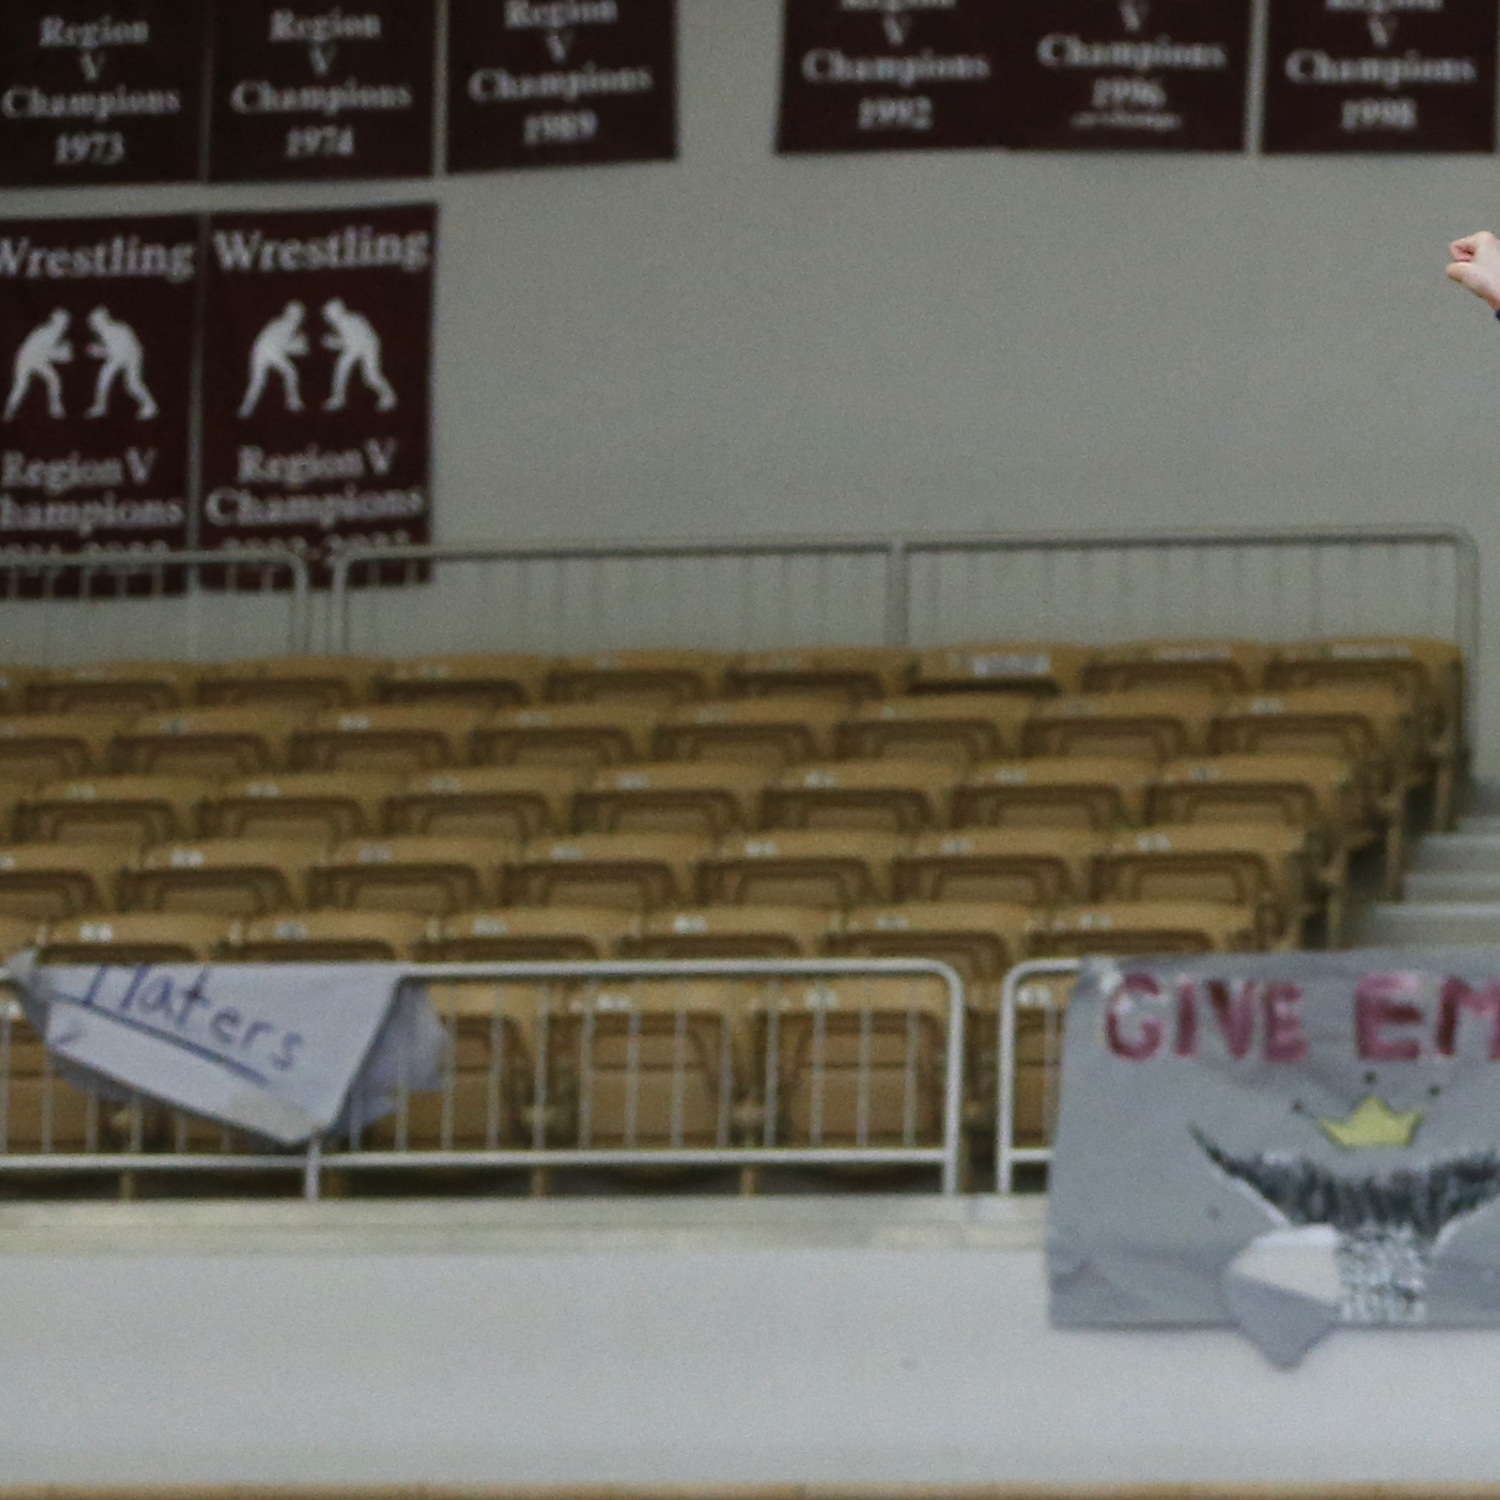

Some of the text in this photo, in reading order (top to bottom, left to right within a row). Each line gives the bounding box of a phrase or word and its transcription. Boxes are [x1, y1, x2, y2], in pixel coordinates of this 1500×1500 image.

[39, 15, 150, 48] Region
[269, 8, 381, 43] Region
[546, 30, 576, 61] V
[81, 52, 107, 82] V
[309, 43, 336, 76] V
[802, 48, 992, 86] Champions
[1036, 33, 1228, 72] Champions
[1284, 48, 1478, 88] Champions
[230, 77, 412, 117] Champions
[467, 62, 653, 104] Champions
[2, 85, 181, 122] Champions
[0, 236, 194, 283] Wrestling
[213, 225, 429, 272] Wrestling
[2, 446, 157, 494] Region V
[237, 437, 397, 487] Region V
[0, 491, 185, 536] hampions
[205, 484, 425, 529] Champions
[1104, 970, 1307, 1062] GIVE
